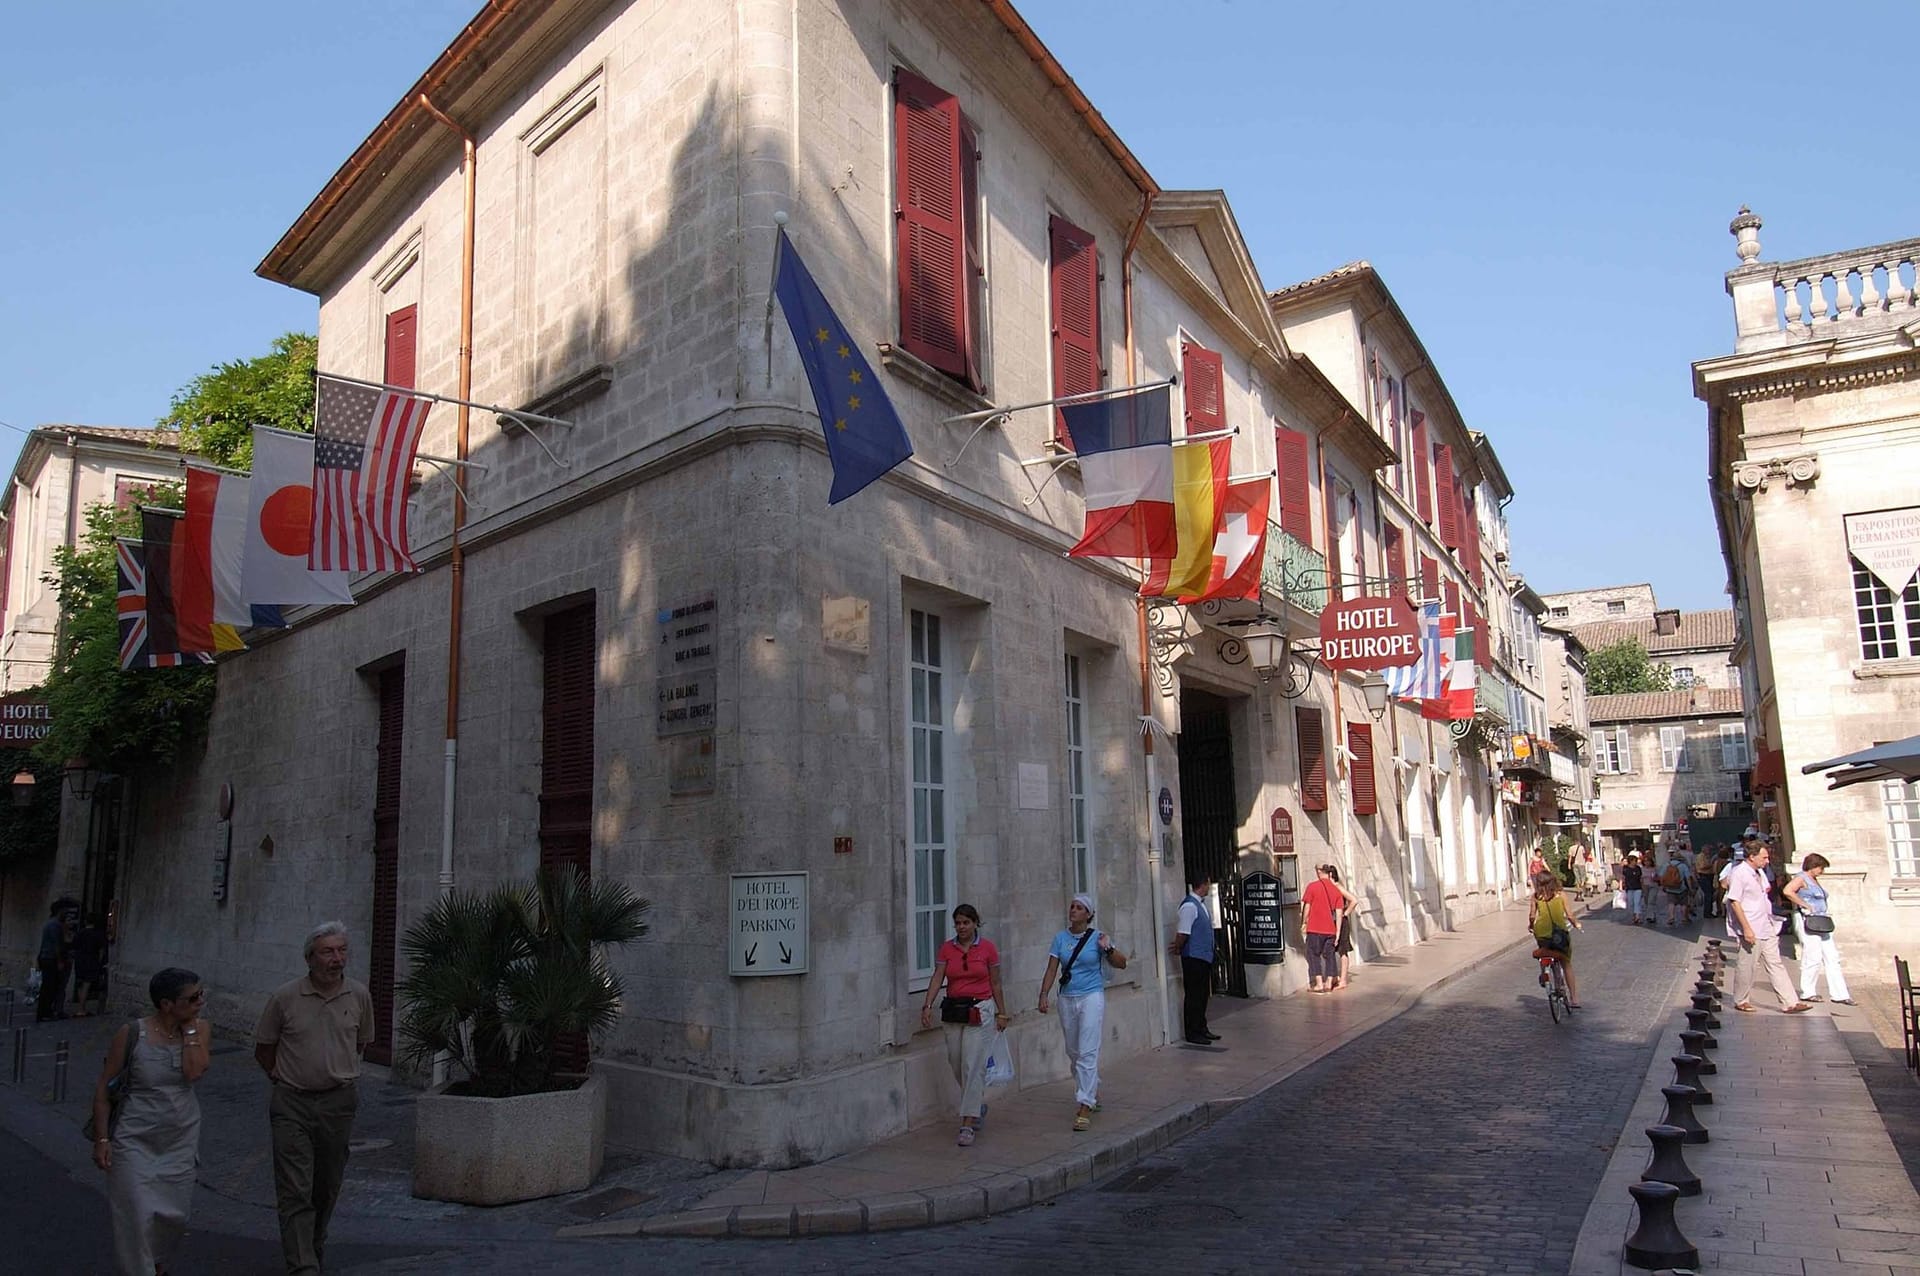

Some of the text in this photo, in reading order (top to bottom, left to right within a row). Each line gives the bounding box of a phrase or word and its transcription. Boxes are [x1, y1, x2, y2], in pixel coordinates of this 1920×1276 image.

[1855, 514, 1920, 532] EXPOSITION
[1873, 547, 1911, 560] GALERIE
[1337, 607, 1398, 631] HOTEL
[1325, 634, 1415, 660] D'EUROPE
[746, 881, 790, 895] HOTEL
[737, 897, 799, 911] D'EUROPE
[740, 918, 796, 932] PARKING
